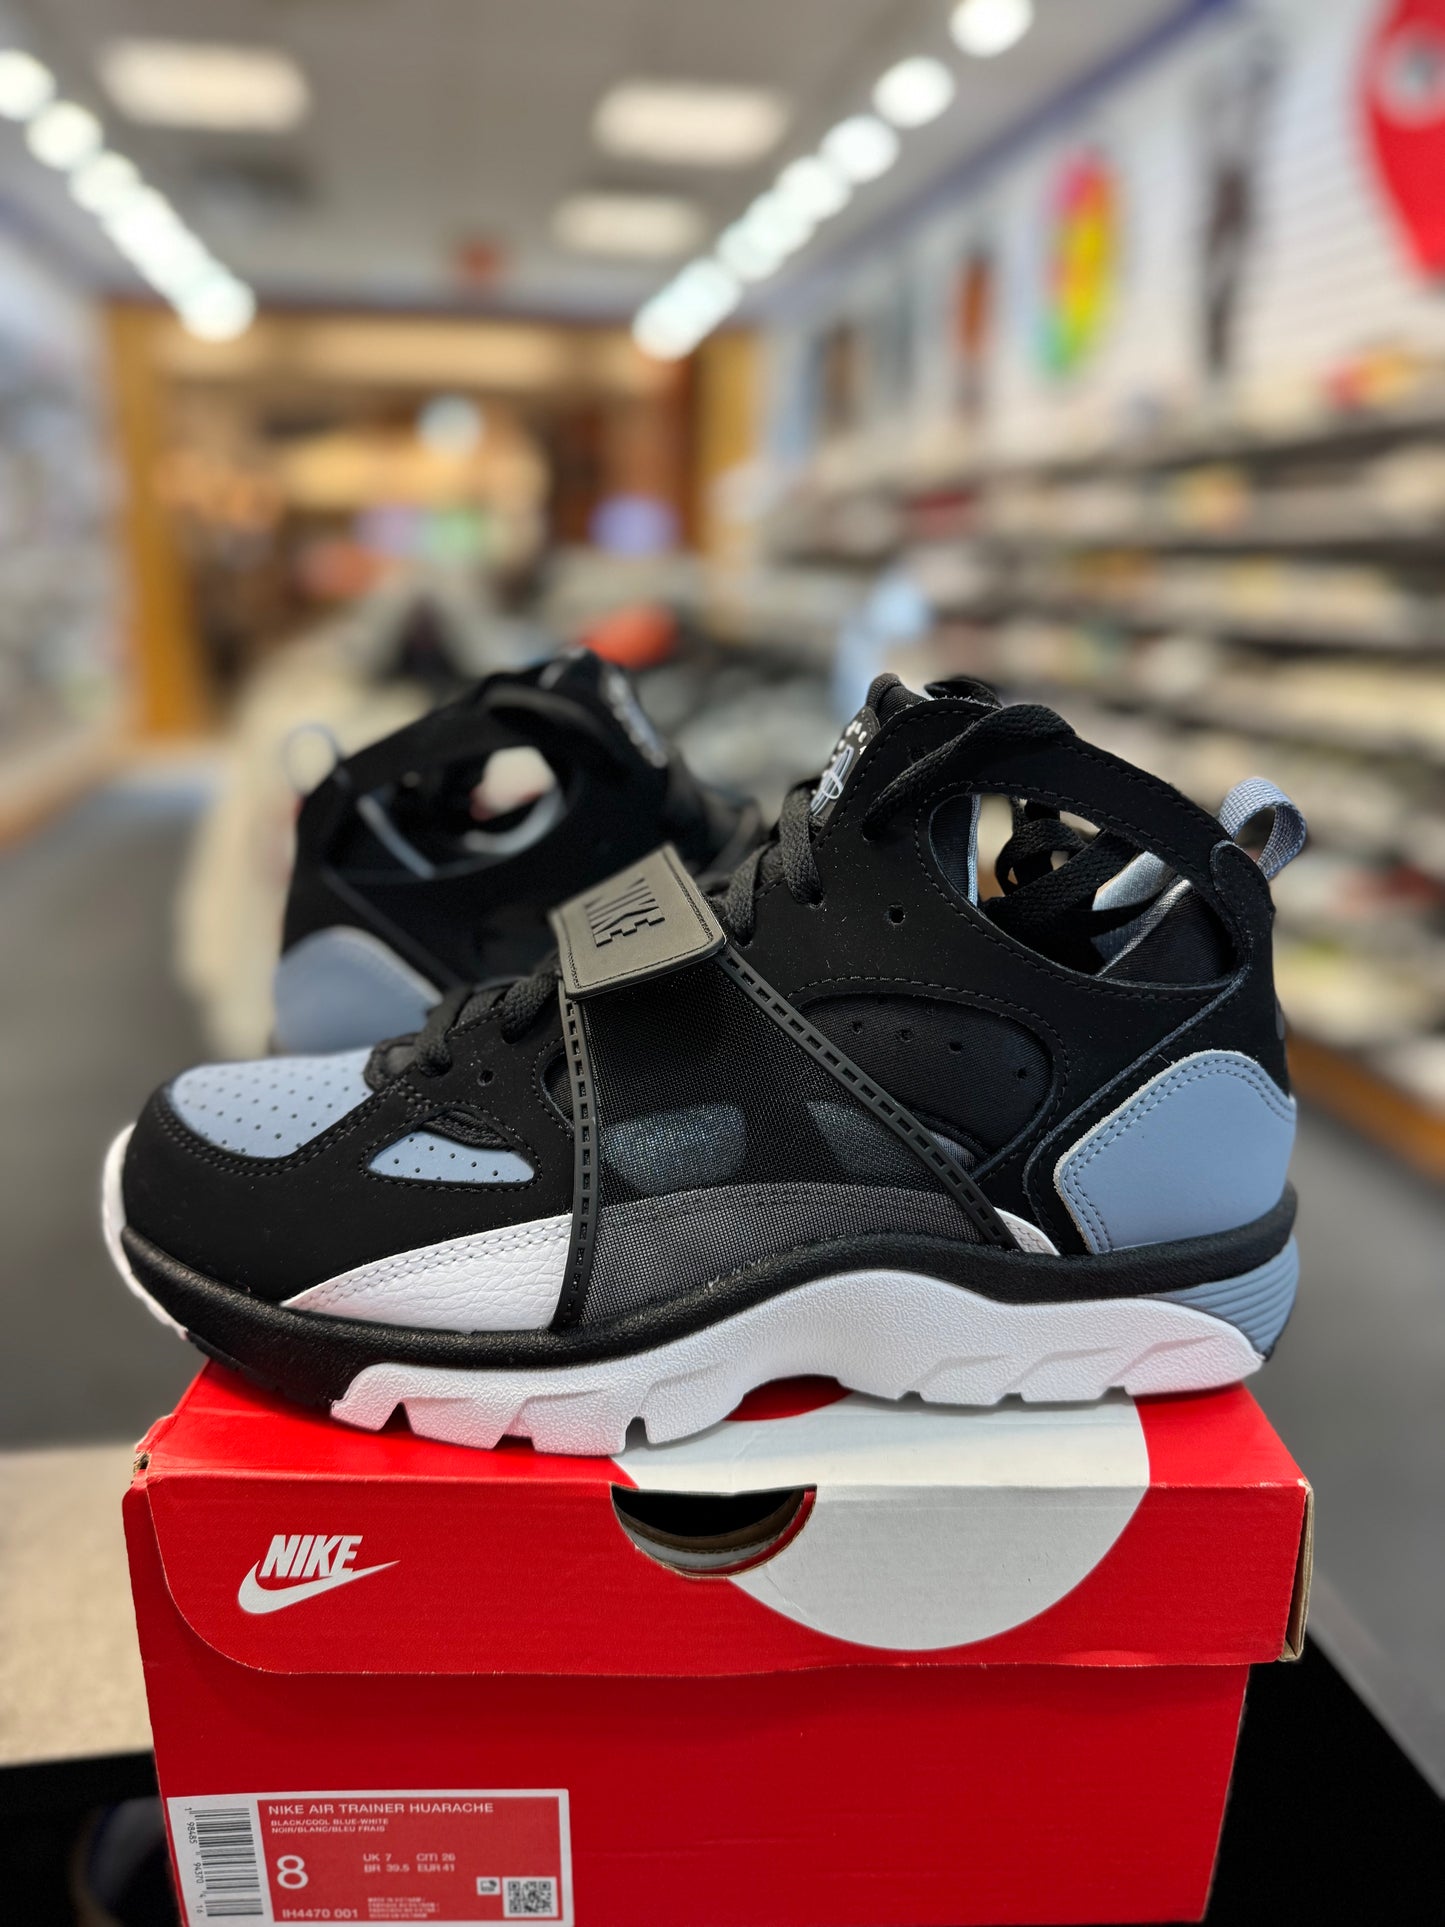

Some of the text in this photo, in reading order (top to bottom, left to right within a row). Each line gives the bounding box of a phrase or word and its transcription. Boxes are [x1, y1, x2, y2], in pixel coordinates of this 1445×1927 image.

[584, 876, 666, 948] NIKE
[258, 1534, 364, 1578] NIKE
[268, 1802, 494, 1815] NIKE AIR TRAINER HUARACHE
[270, 1817, 389, 1826] BLACK/COOL BLUE-WHITE
[358, 1825, 386, 1833] FRAIS
[363, 1853, 381, 1862] UK
[385, 1853, 392, 1862] 7
[276, 1854, 308, 1890] 8
[417, 1863, 441, 1873] EUR
[442, 1863, 456, 1873] 41
[334, 1908, 358, 1918] 001
